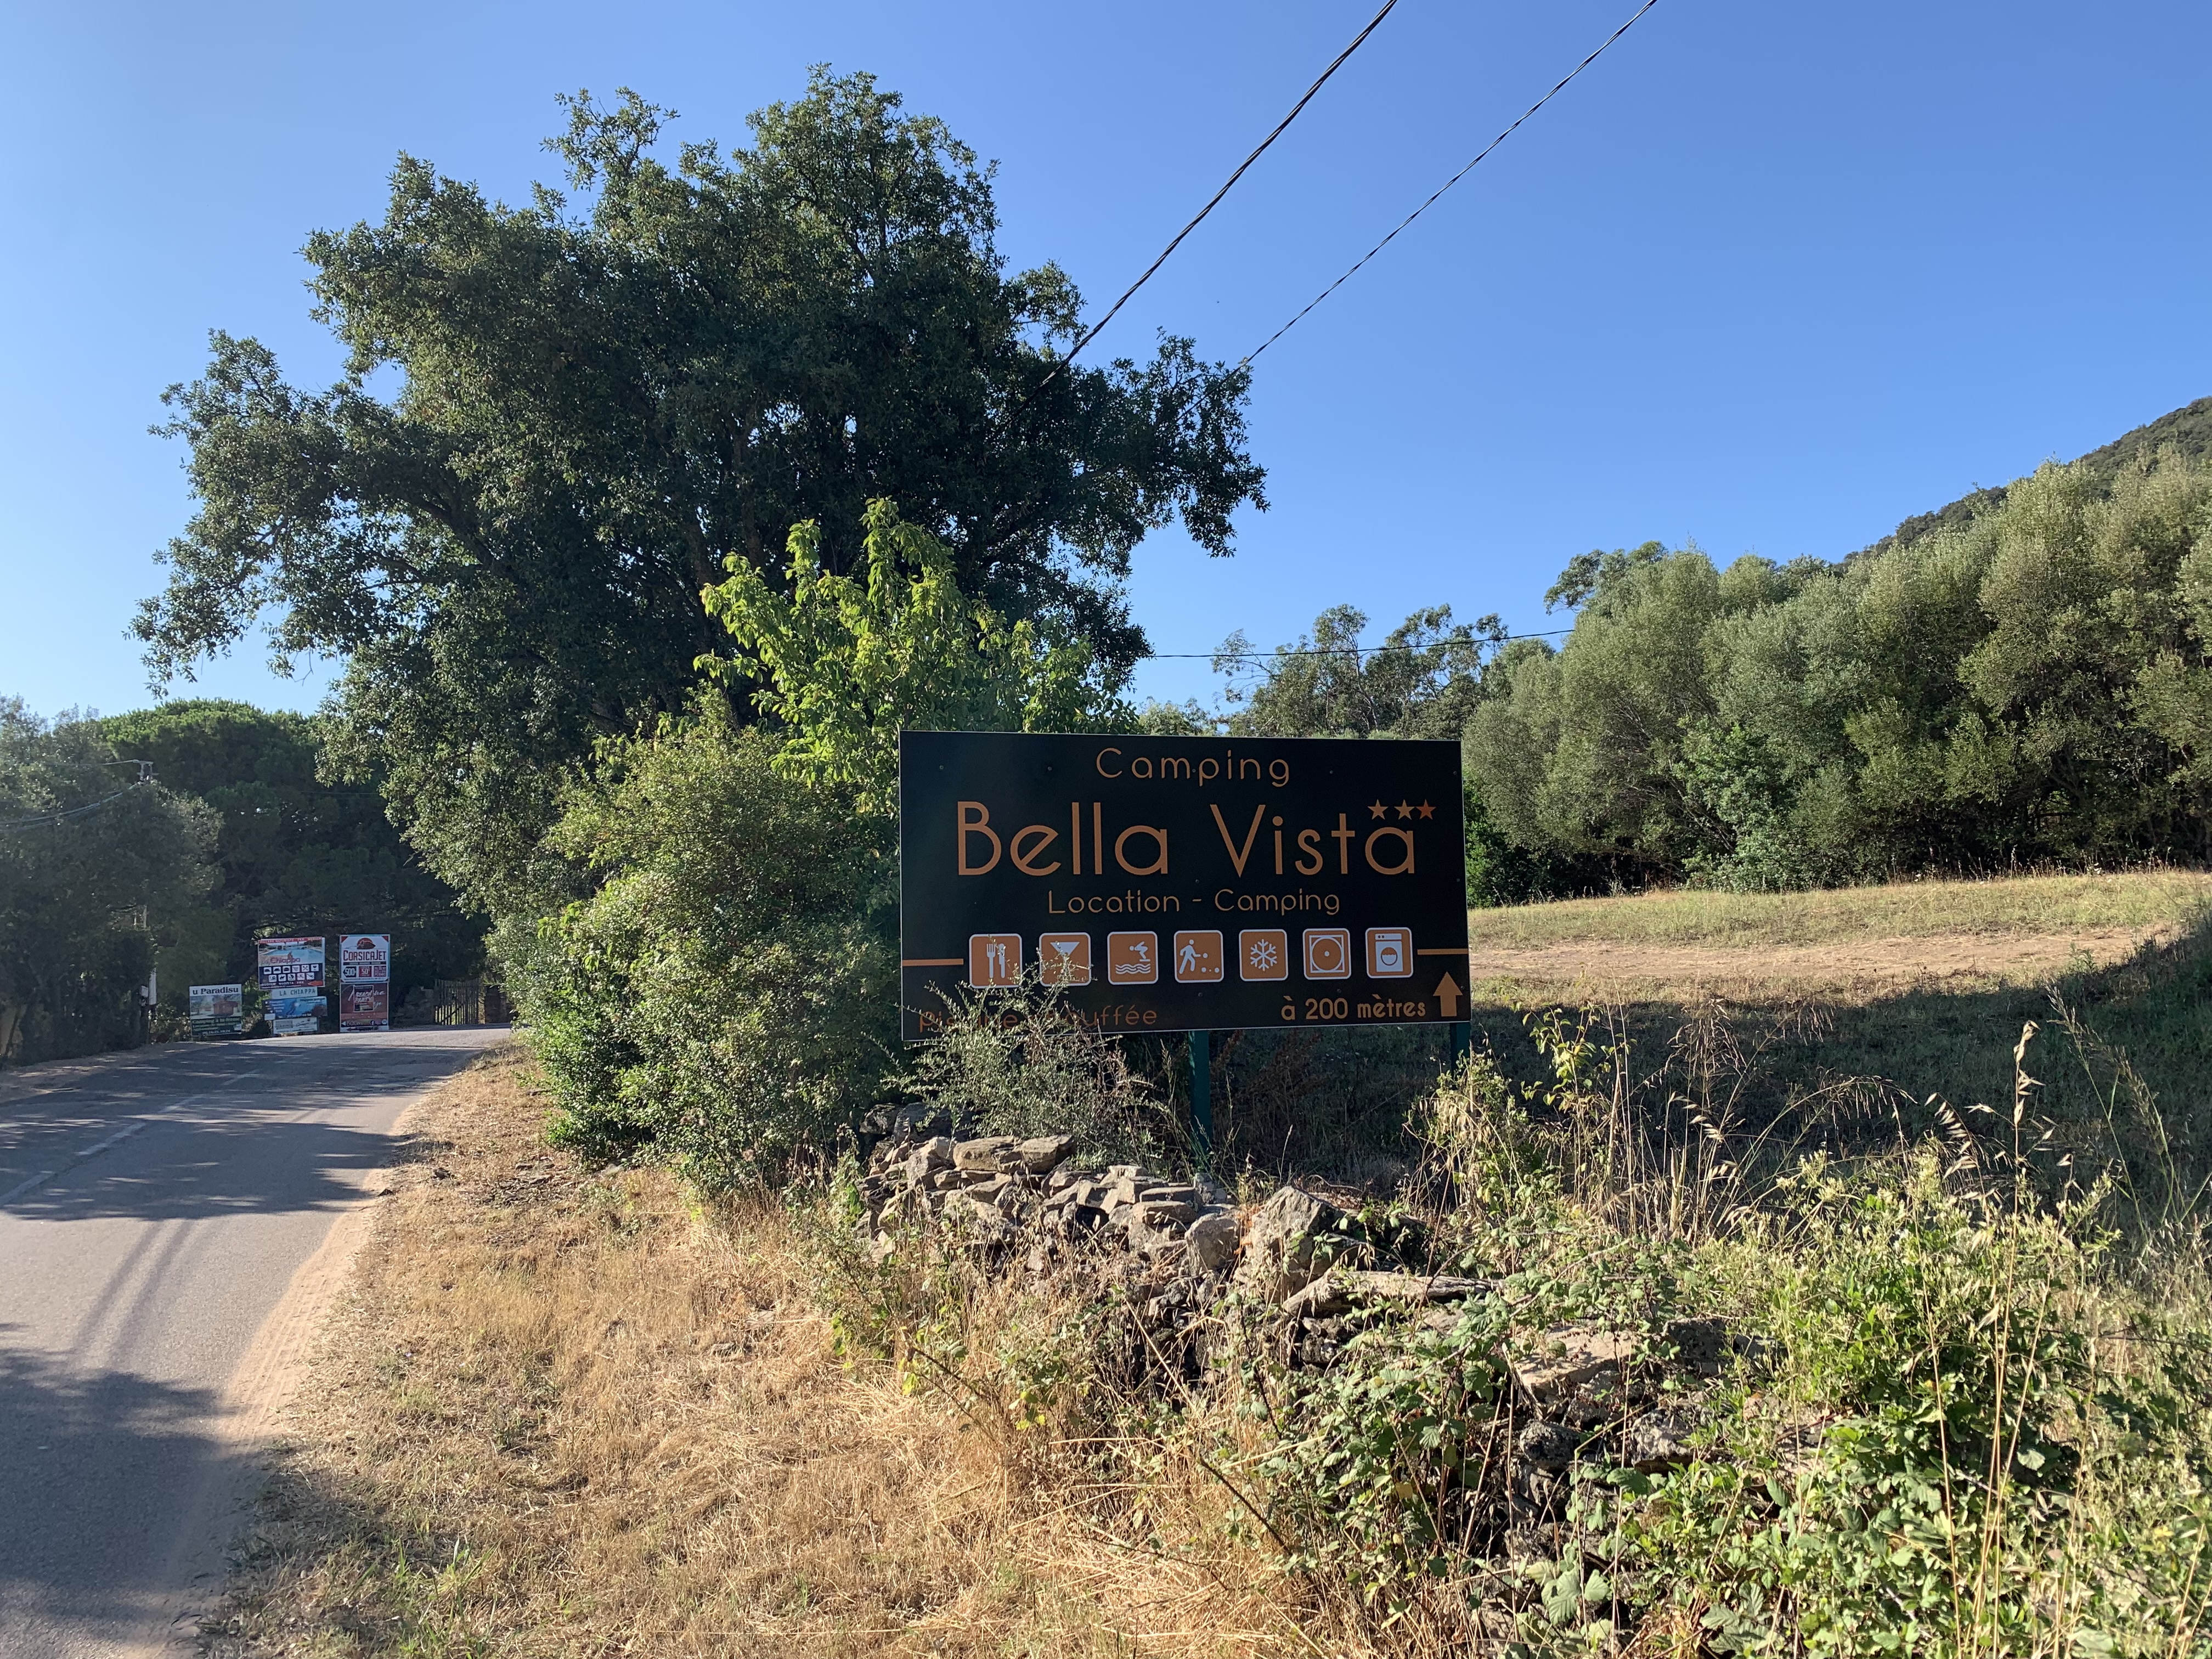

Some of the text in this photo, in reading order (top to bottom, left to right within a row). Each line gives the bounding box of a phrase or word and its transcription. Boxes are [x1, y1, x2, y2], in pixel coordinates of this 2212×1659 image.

[1096, 747, 1290, 787] Camping
[957, 801, 1415, 877] Bella Vista
[1048, 889, 1180, 914] Location
[1215, 888, 1340, 915] Camping
[201, 986, 239, 995] Paradisu
[1281, 994, 1426, 1020] à 200 mètres
